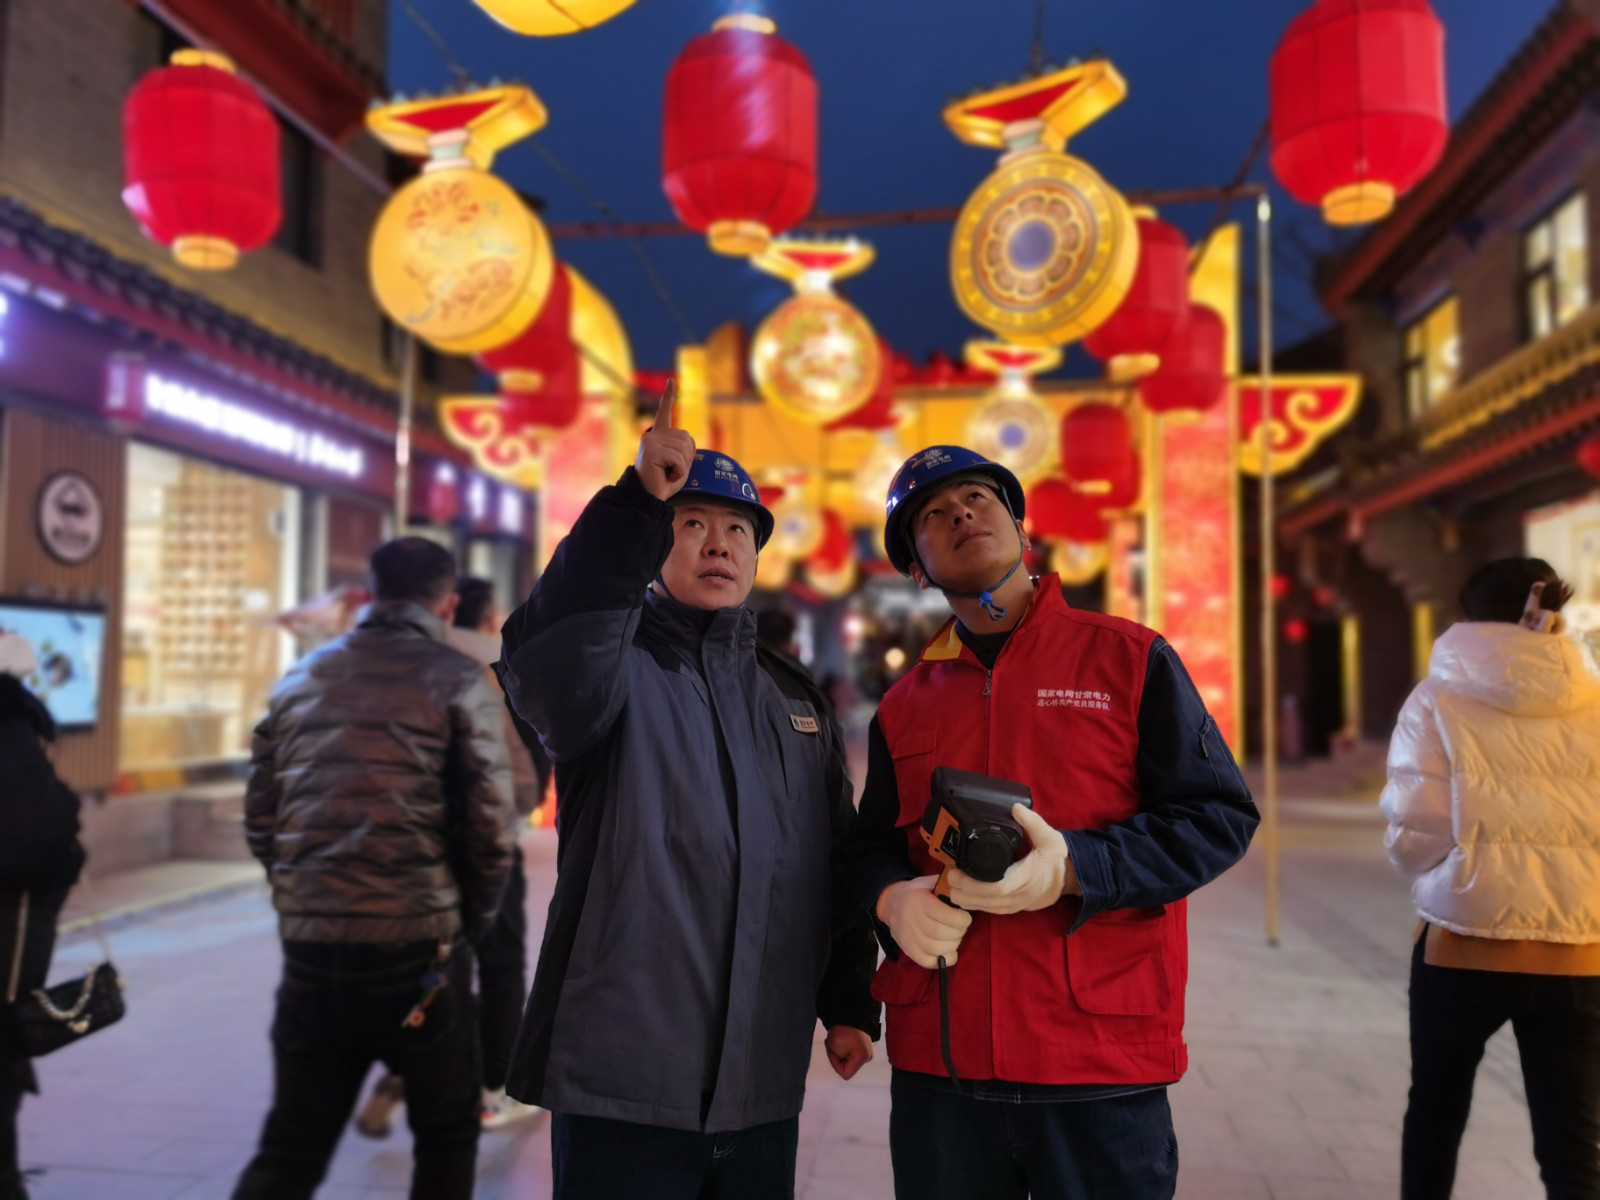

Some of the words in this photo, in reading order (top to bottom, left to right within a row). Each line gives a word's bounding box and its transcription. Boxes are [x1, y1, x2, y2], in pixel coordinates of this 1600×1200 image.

[1037, 689, 1111, 702] 国家电网甘肃电力
